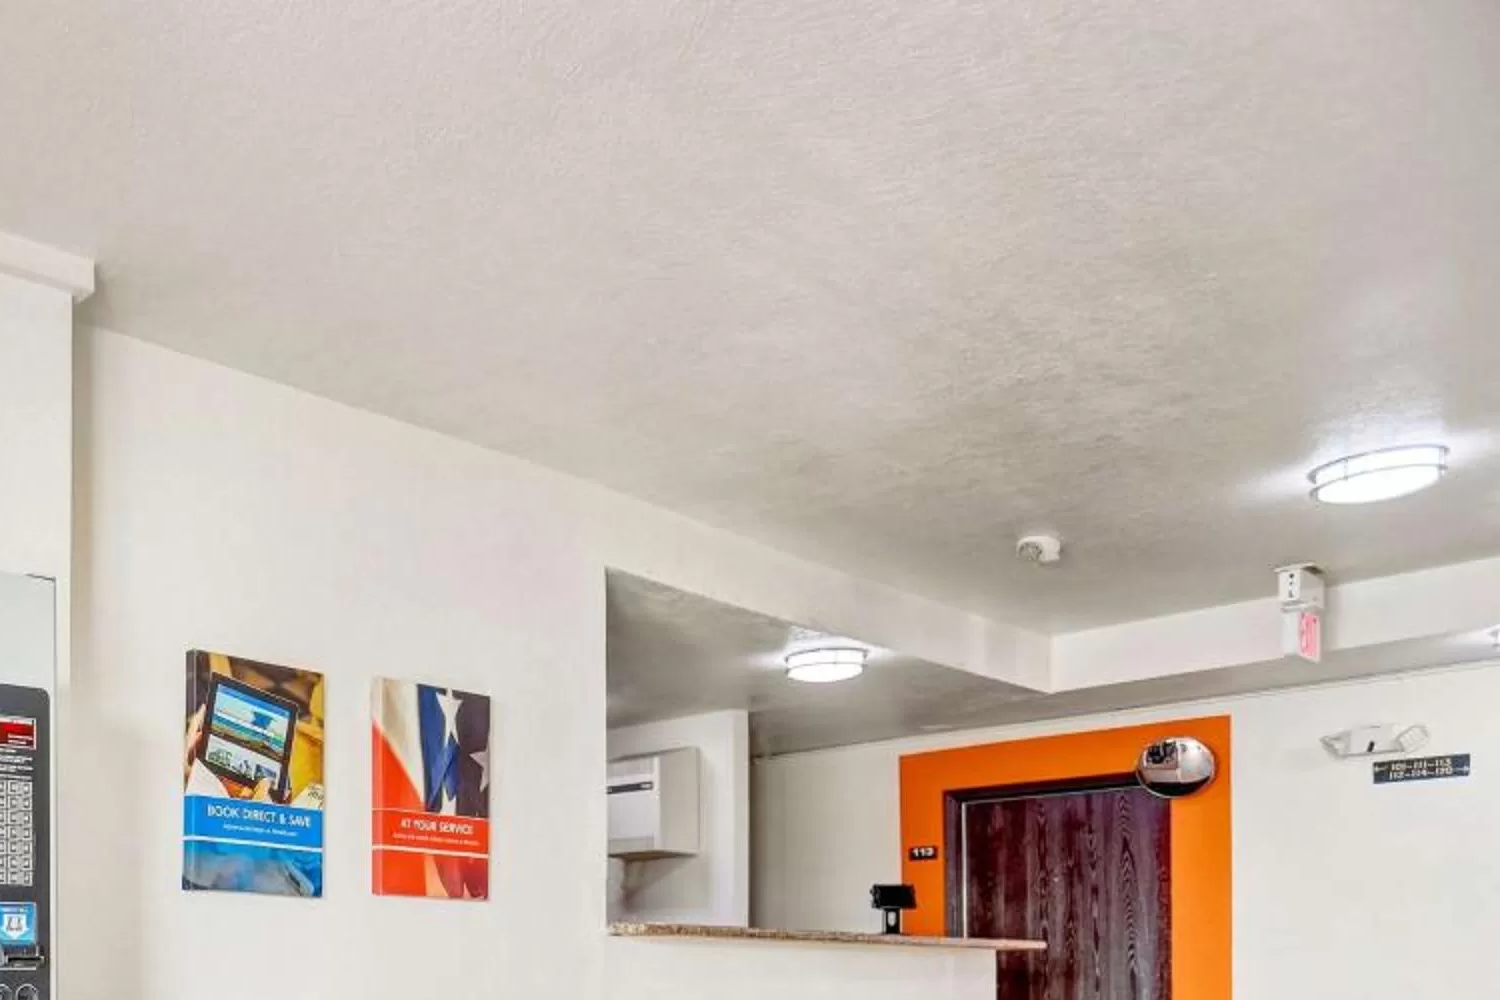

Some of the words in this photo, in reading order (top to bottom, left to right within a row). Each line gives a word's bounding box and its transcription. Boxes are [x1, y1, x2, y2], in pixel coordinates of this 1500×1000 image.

[207, 803, 241, 818] BOOK
[243, 808, 277, 823] DIRECT
[289, 815, 311, 829] SAVE
[413, 819, 437, 832] YOUR
[439, 821, 474, 835] SERVICE
